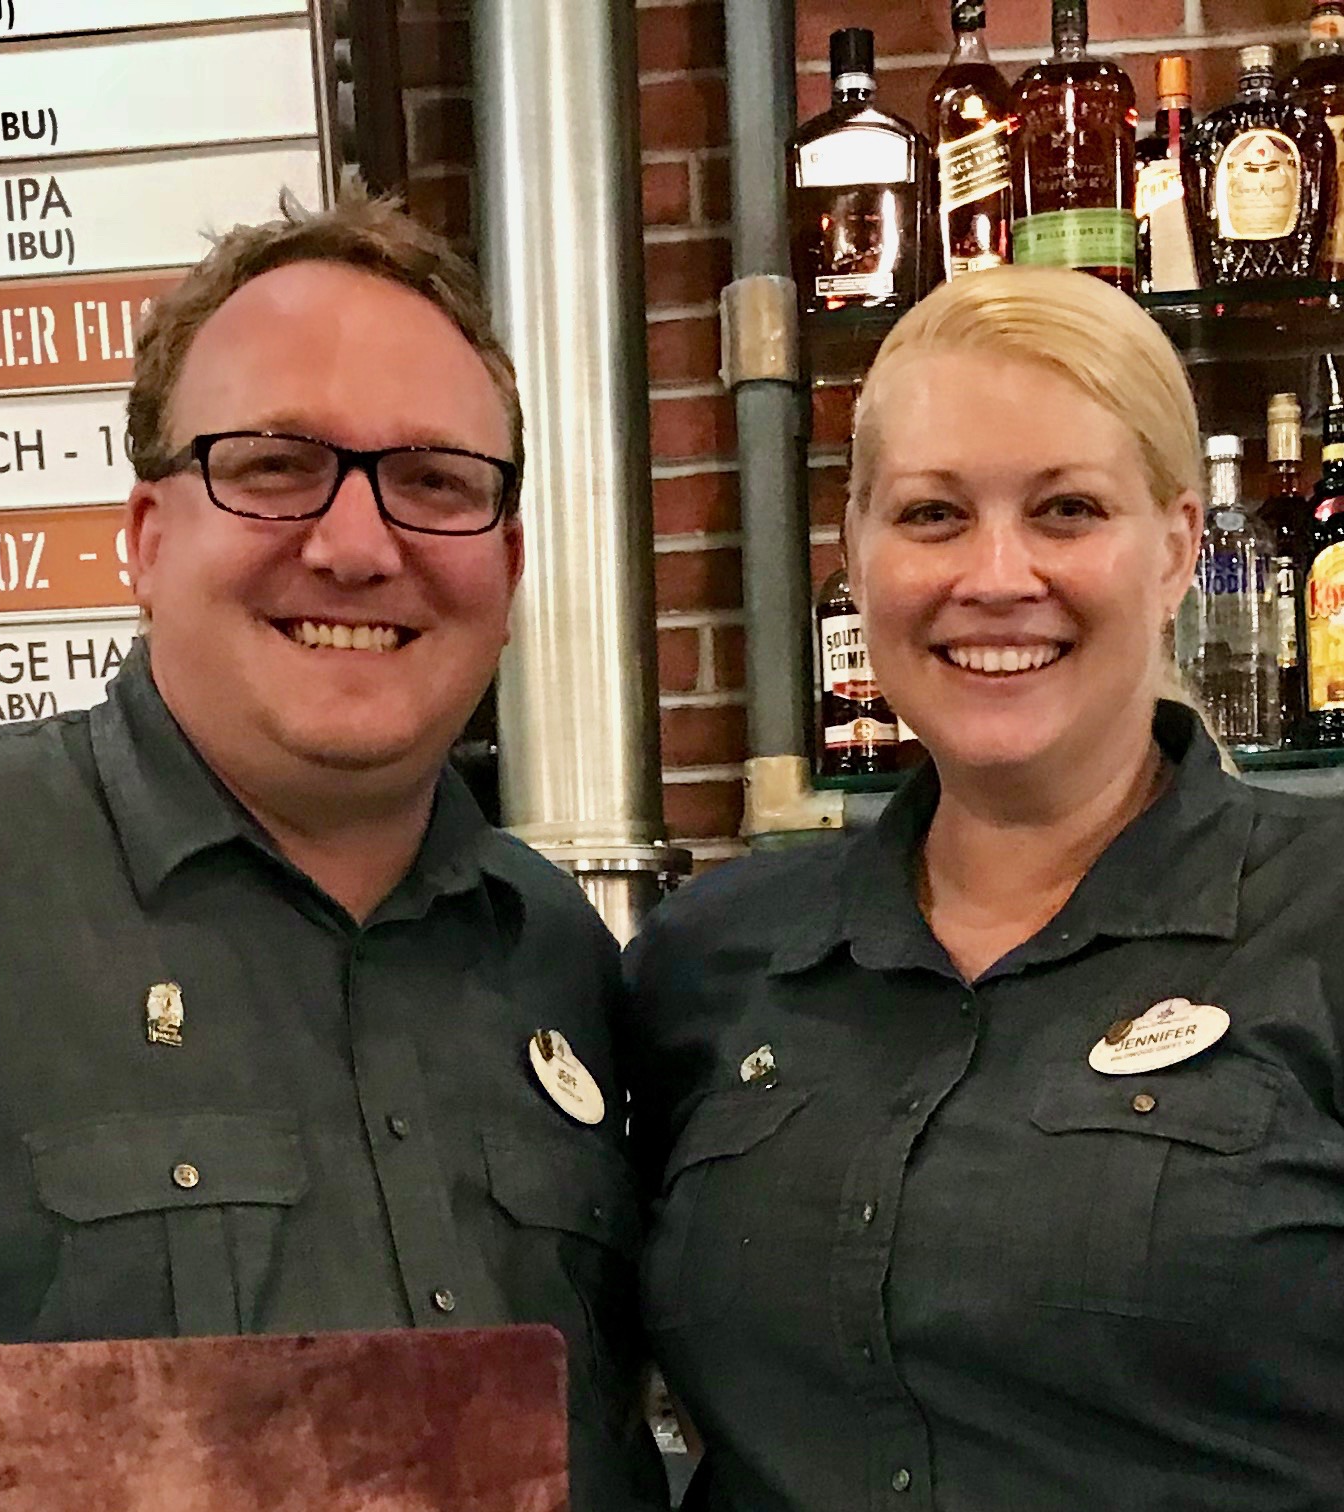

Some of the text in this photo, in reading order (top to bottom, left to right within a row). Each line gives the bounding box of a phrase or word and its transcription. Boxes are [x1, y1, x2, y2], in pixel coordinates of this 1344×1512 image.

[4, 175, 72, 222] IPA
[8, 227, 75, 266] IBU)
[99, 425, 134, 466] 1
[65, 636, 144, 680] HA
[1115, 1024, 1198, 1053] JENNIFER
